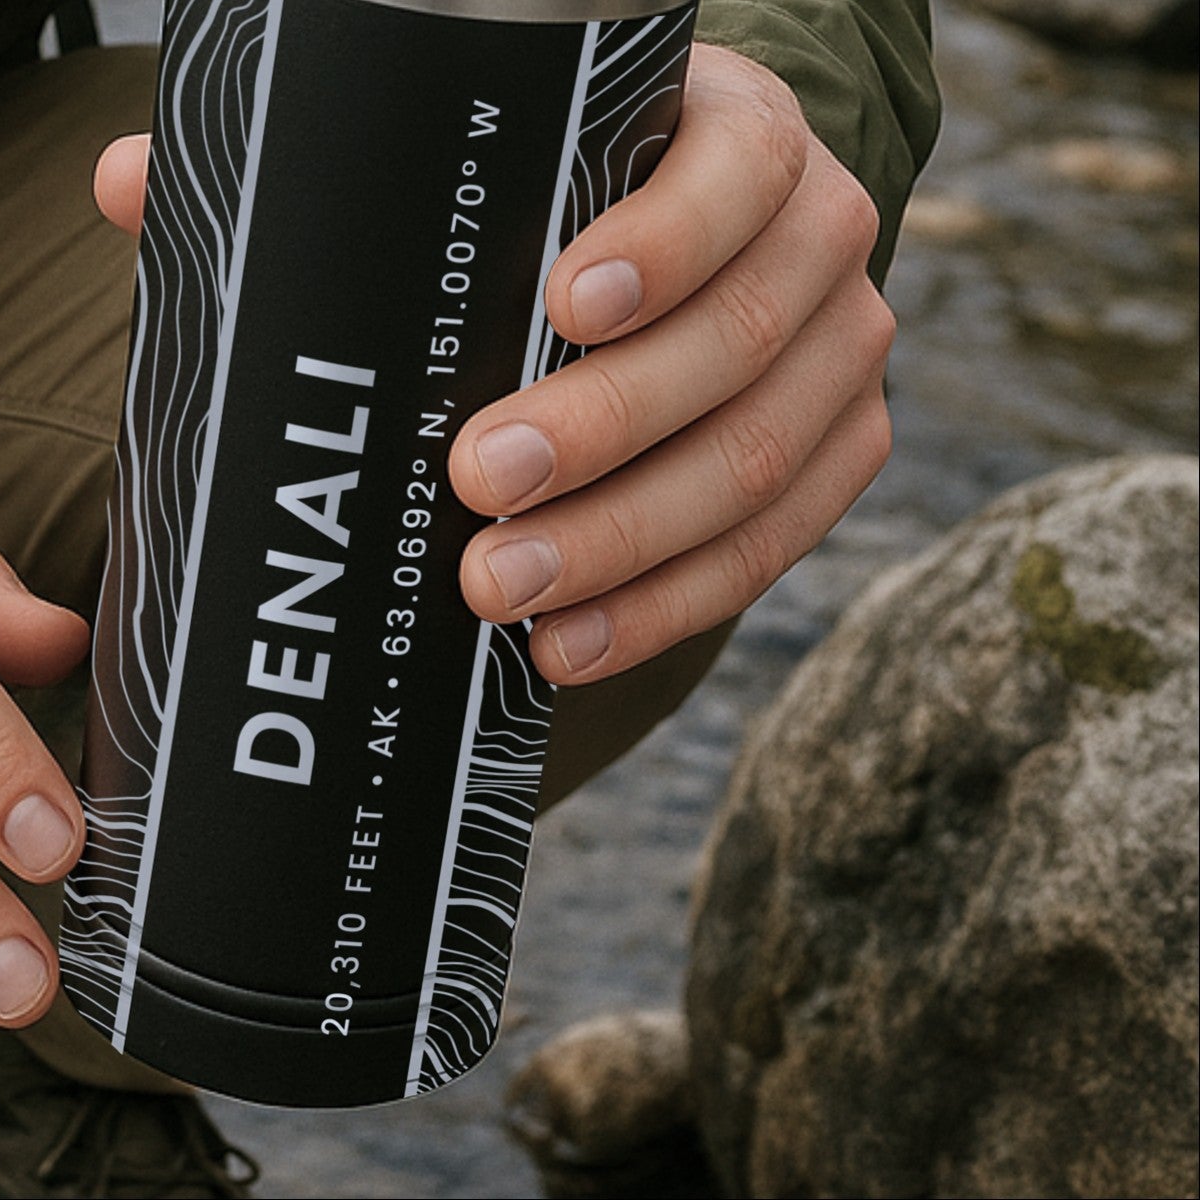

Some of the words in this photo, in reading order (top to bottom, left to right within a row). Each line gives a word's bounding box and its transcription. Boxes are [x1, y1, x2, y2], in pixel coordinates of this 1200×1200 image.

[468, 99, 500, 138] W
[426, 160, 485, 375] 151.0070°
[418, 399, 455, 438] N,
[233, 355, 376, 786] DENALI
[382, 459, 437, 656] 63.0692°
[367, 706, 400, 758] AK
[345, 805, 383, 892] FEET
[320, 913, 366, 1036] 20,310
